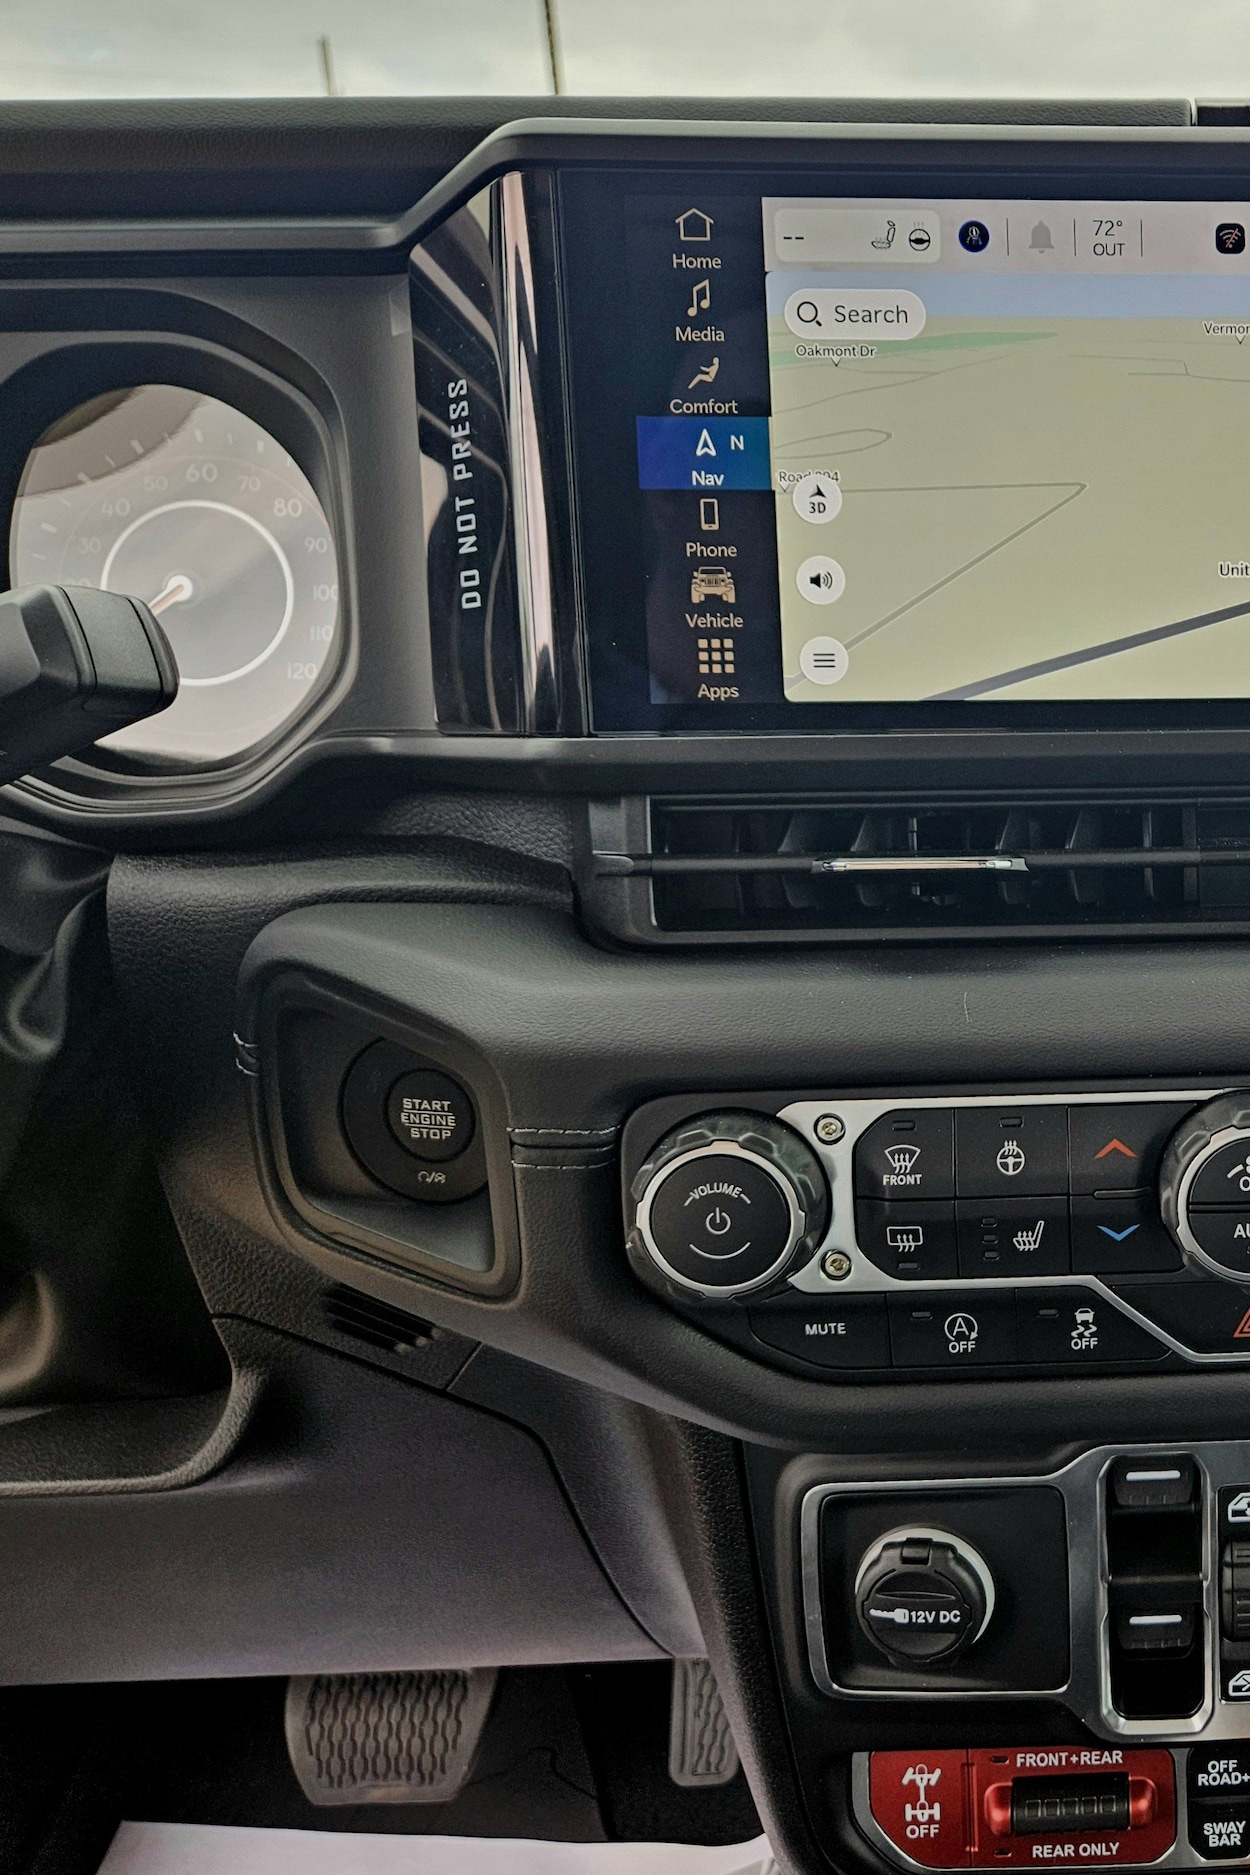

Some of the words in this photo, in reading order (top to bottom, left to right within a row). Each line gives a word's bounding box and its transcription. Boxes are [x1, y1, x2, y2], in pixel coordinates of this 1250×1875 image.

[1092, 219, 1123, 238] 72°
[1092, 242, 1126, 258] OUT
[672, 254, 722, 270] Home
[833, 305, 909, 326] Search
[675, 326, 725, 343] Media
[795, 344, 857, 358] Oakmont
[859, 344, 876, 358] Dr
[669, 398, 738, 415] Comfort
[448, 378, 473, 481] PRESS
[730, 435, 744, 450] N
[187, 462, 218, 482] 60
[691, 471, 724, 487] Nav
[238, 475, 261, 491] 70
[101, 498, 130, 517] 40
[274, 498, 302, 517] 80
[809, 501, 826, 514] 3D
[455, 496, 478, 555] NOT
[305, 537, 328, 553] 90
[685, 541, 737, 558] Phone
[460, 569, 482, 609] DO
[685, 613, 743, 629] Vehicle
[310, 625, 334, 641] 110
[287, 662, 317, 680] 120
[698, 683, 739, 701] Apps
[403, 1098, 450, 1111] START
[401, 1112, 456, 1126] ENGINE
[410, 1127, 452, 1140] STOP
[882, 1173, 922, 1186] FRONT
[691, 1183, 742, 1199] VOLUME
[804, 1322, 846, 1336] MUTE
[949, 1340, 976, 1354] OFF
[1071, 1337, 1098, 1350] OFF
[910, 1610, 937, 1623] 12V
[939, 1610, 961, 1623] DC
[1207, 1759, 1238, 1773] OFF
[1197, 1772, 1250, 1786] ROAD+
[906, 1824, 940, 1839] OFF
[1203, 1821, 1246, 1835] SWAY
[1208, 1834, 1241, 1847] BAR
[1032, 1844, 1075, 1858] REAR
[1078, 1842, 1120, 1857] ONLY
